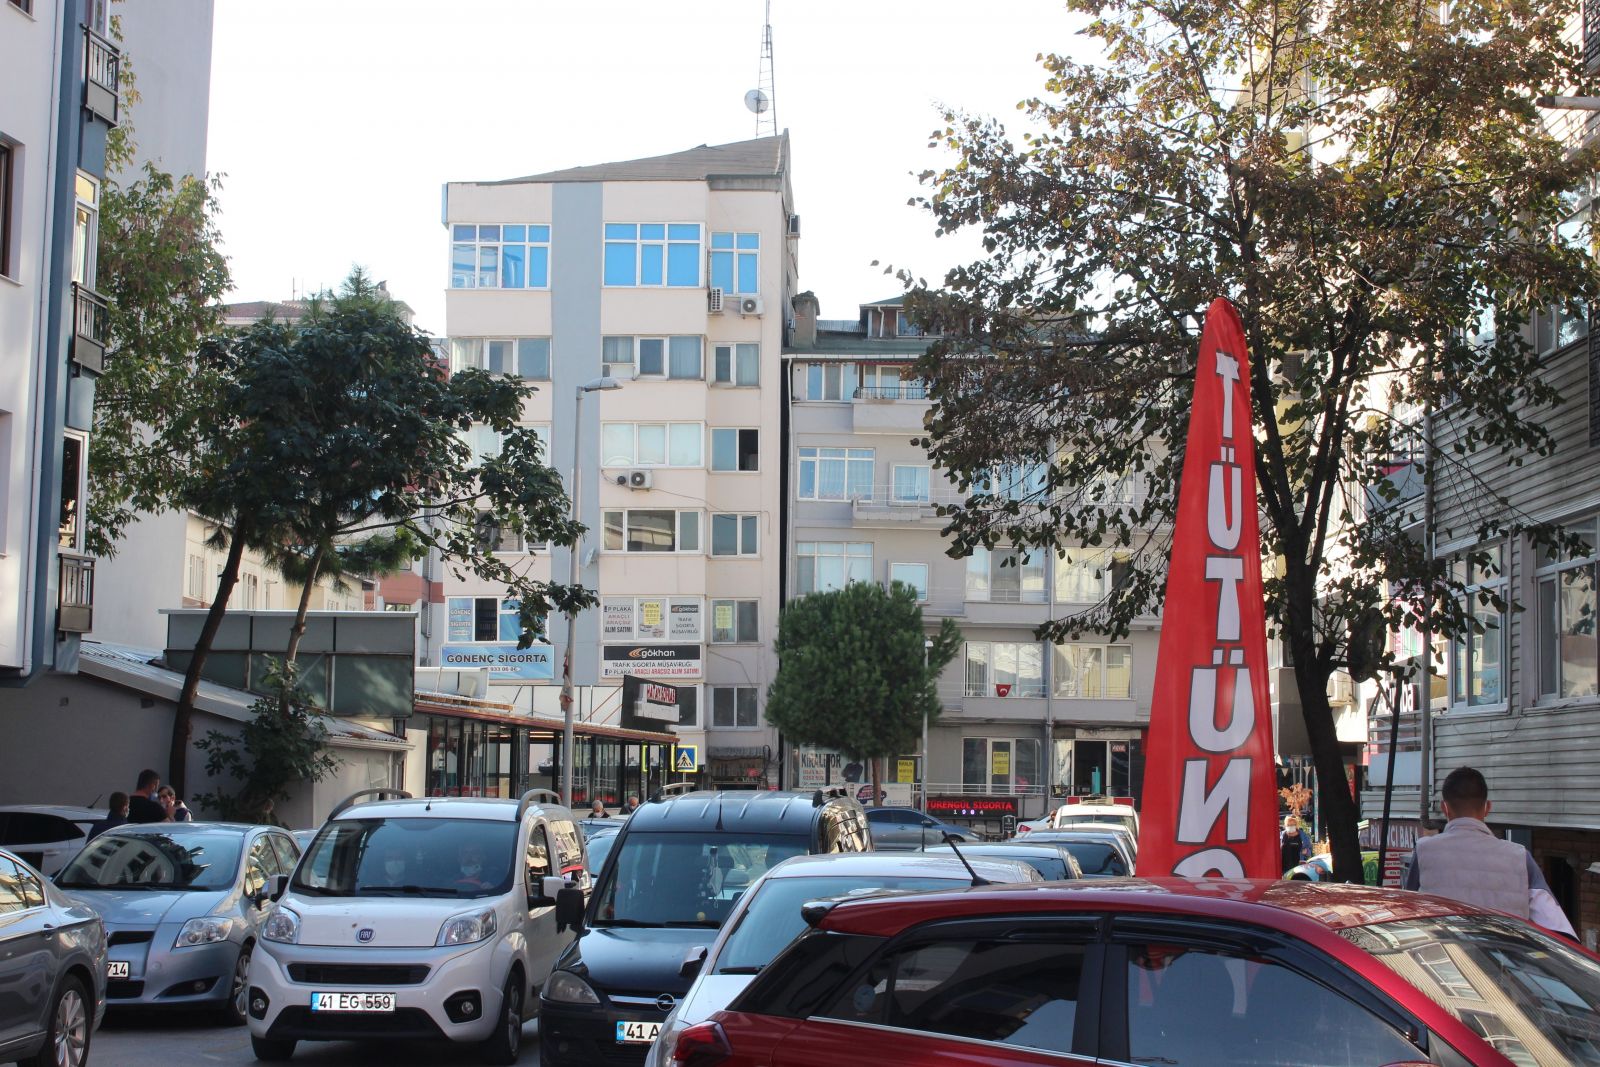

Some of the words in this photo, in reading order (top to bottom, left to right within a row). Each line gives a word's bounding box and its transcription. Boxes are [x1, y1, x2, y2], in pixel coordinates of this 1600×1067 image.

[447, 654, 494, 664] GÖNENÇ
[641, 650, 675, 658] gökhan
[360, 930, 372, 938] FIAT
[319, 994, 334, 1009] 41
[338, 994, 360, 1009] EG
[365, 995, 391, 1009] 559
[626, 1023, 645, 1039] 41
